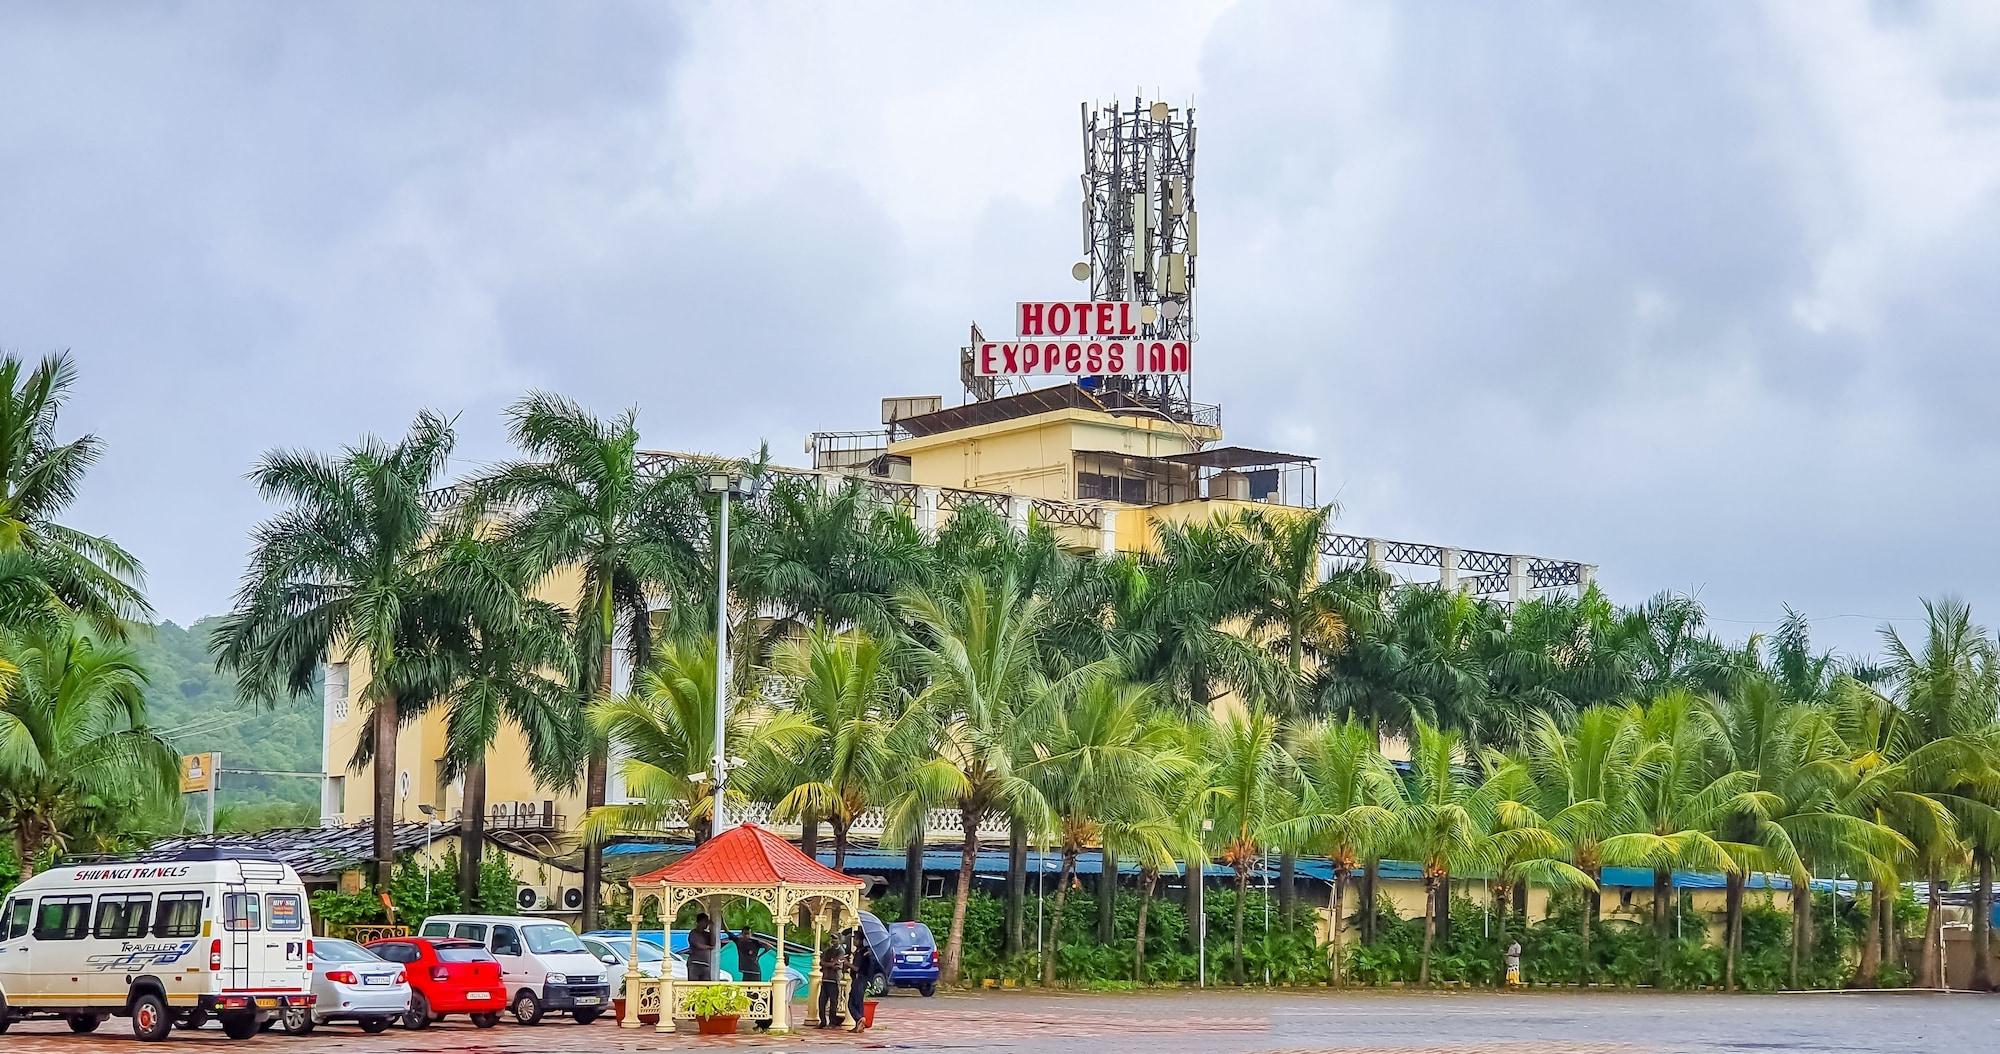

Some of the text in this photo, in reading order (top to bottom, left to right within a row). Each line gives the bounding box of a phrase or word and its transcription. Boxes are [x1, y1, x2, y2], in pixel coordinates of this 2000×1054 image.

[1022, 303, 1136, 336] HOTEL
[1136, 342, 1188, 374] Inn
[74, 866, 190, 881] SHIVANGI TRAVELS
[121, 941, 178, 952] TRAVELLER
